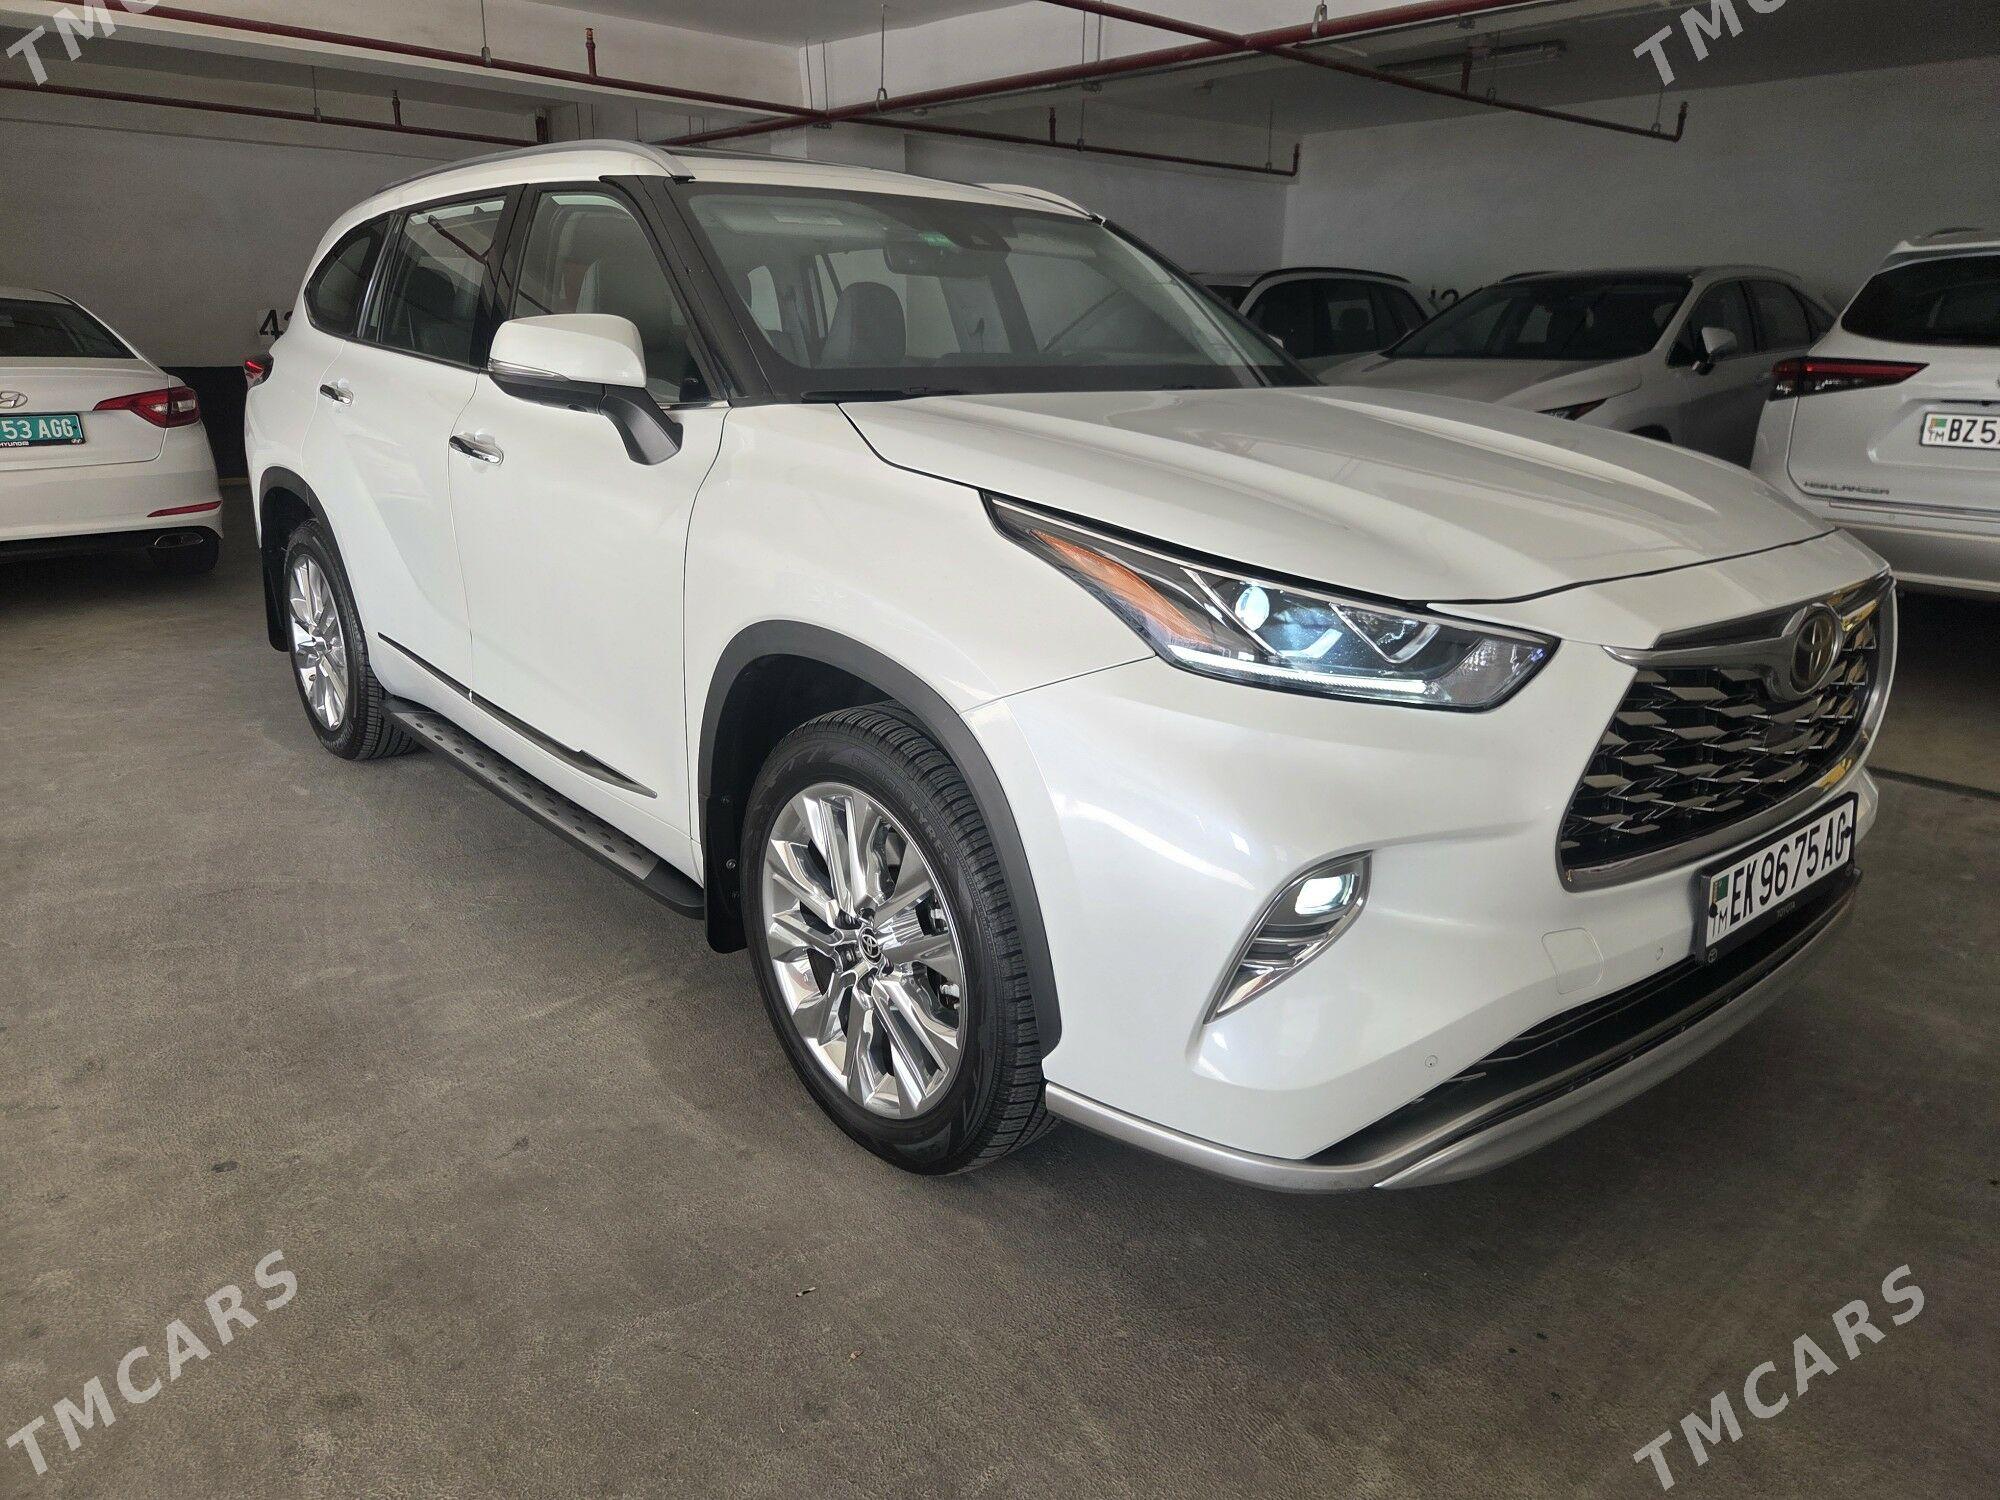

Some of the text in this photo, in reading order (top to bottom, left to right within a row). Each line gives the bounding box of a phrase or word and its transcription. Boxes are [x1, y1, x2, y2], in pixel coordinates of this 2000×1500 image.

[0, 418, 74, 439] 53 AGG
[1947, 418, 2000, 444] BZ5
